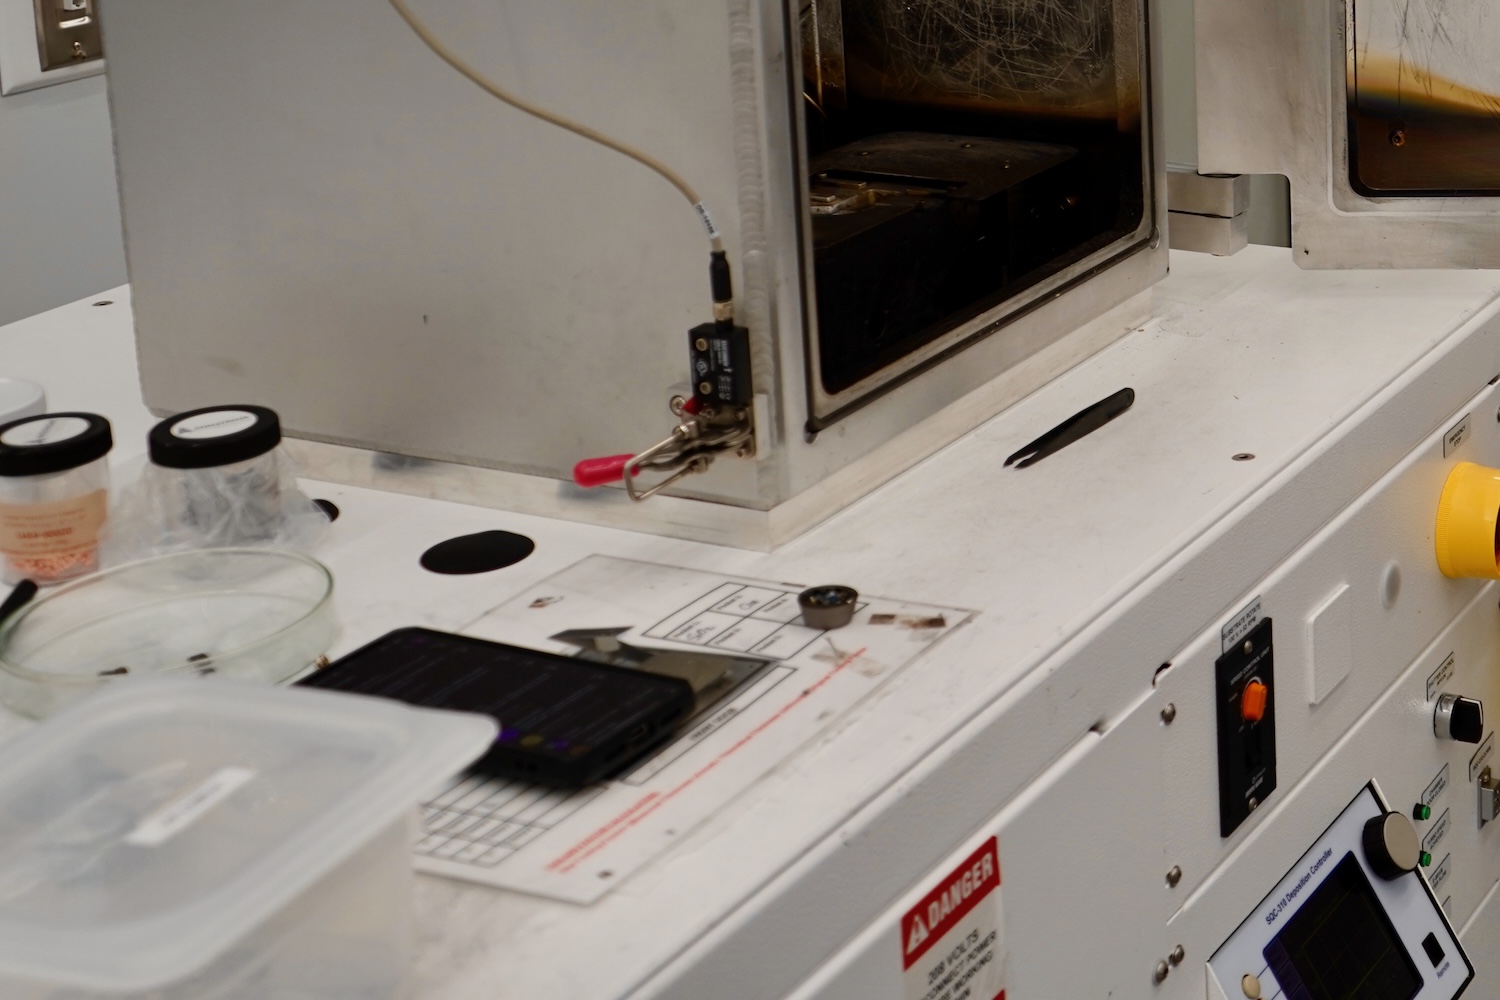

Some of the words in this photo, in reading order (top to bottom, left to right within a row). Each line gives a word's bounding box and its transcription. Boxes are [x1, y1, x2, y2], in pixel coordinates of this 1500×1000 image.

[928, 852, 993, 930] DANGER
[1265, 898, 1287, 925] SQC-310
[1285, 872, 1312, 903] Deposition
[1309, 847, 1333, 875] Controller
[946, 928, 979, 966] VOLTS
[966, 929, 997, 962] POWER
[953, 950, 993, 993] WORKING
